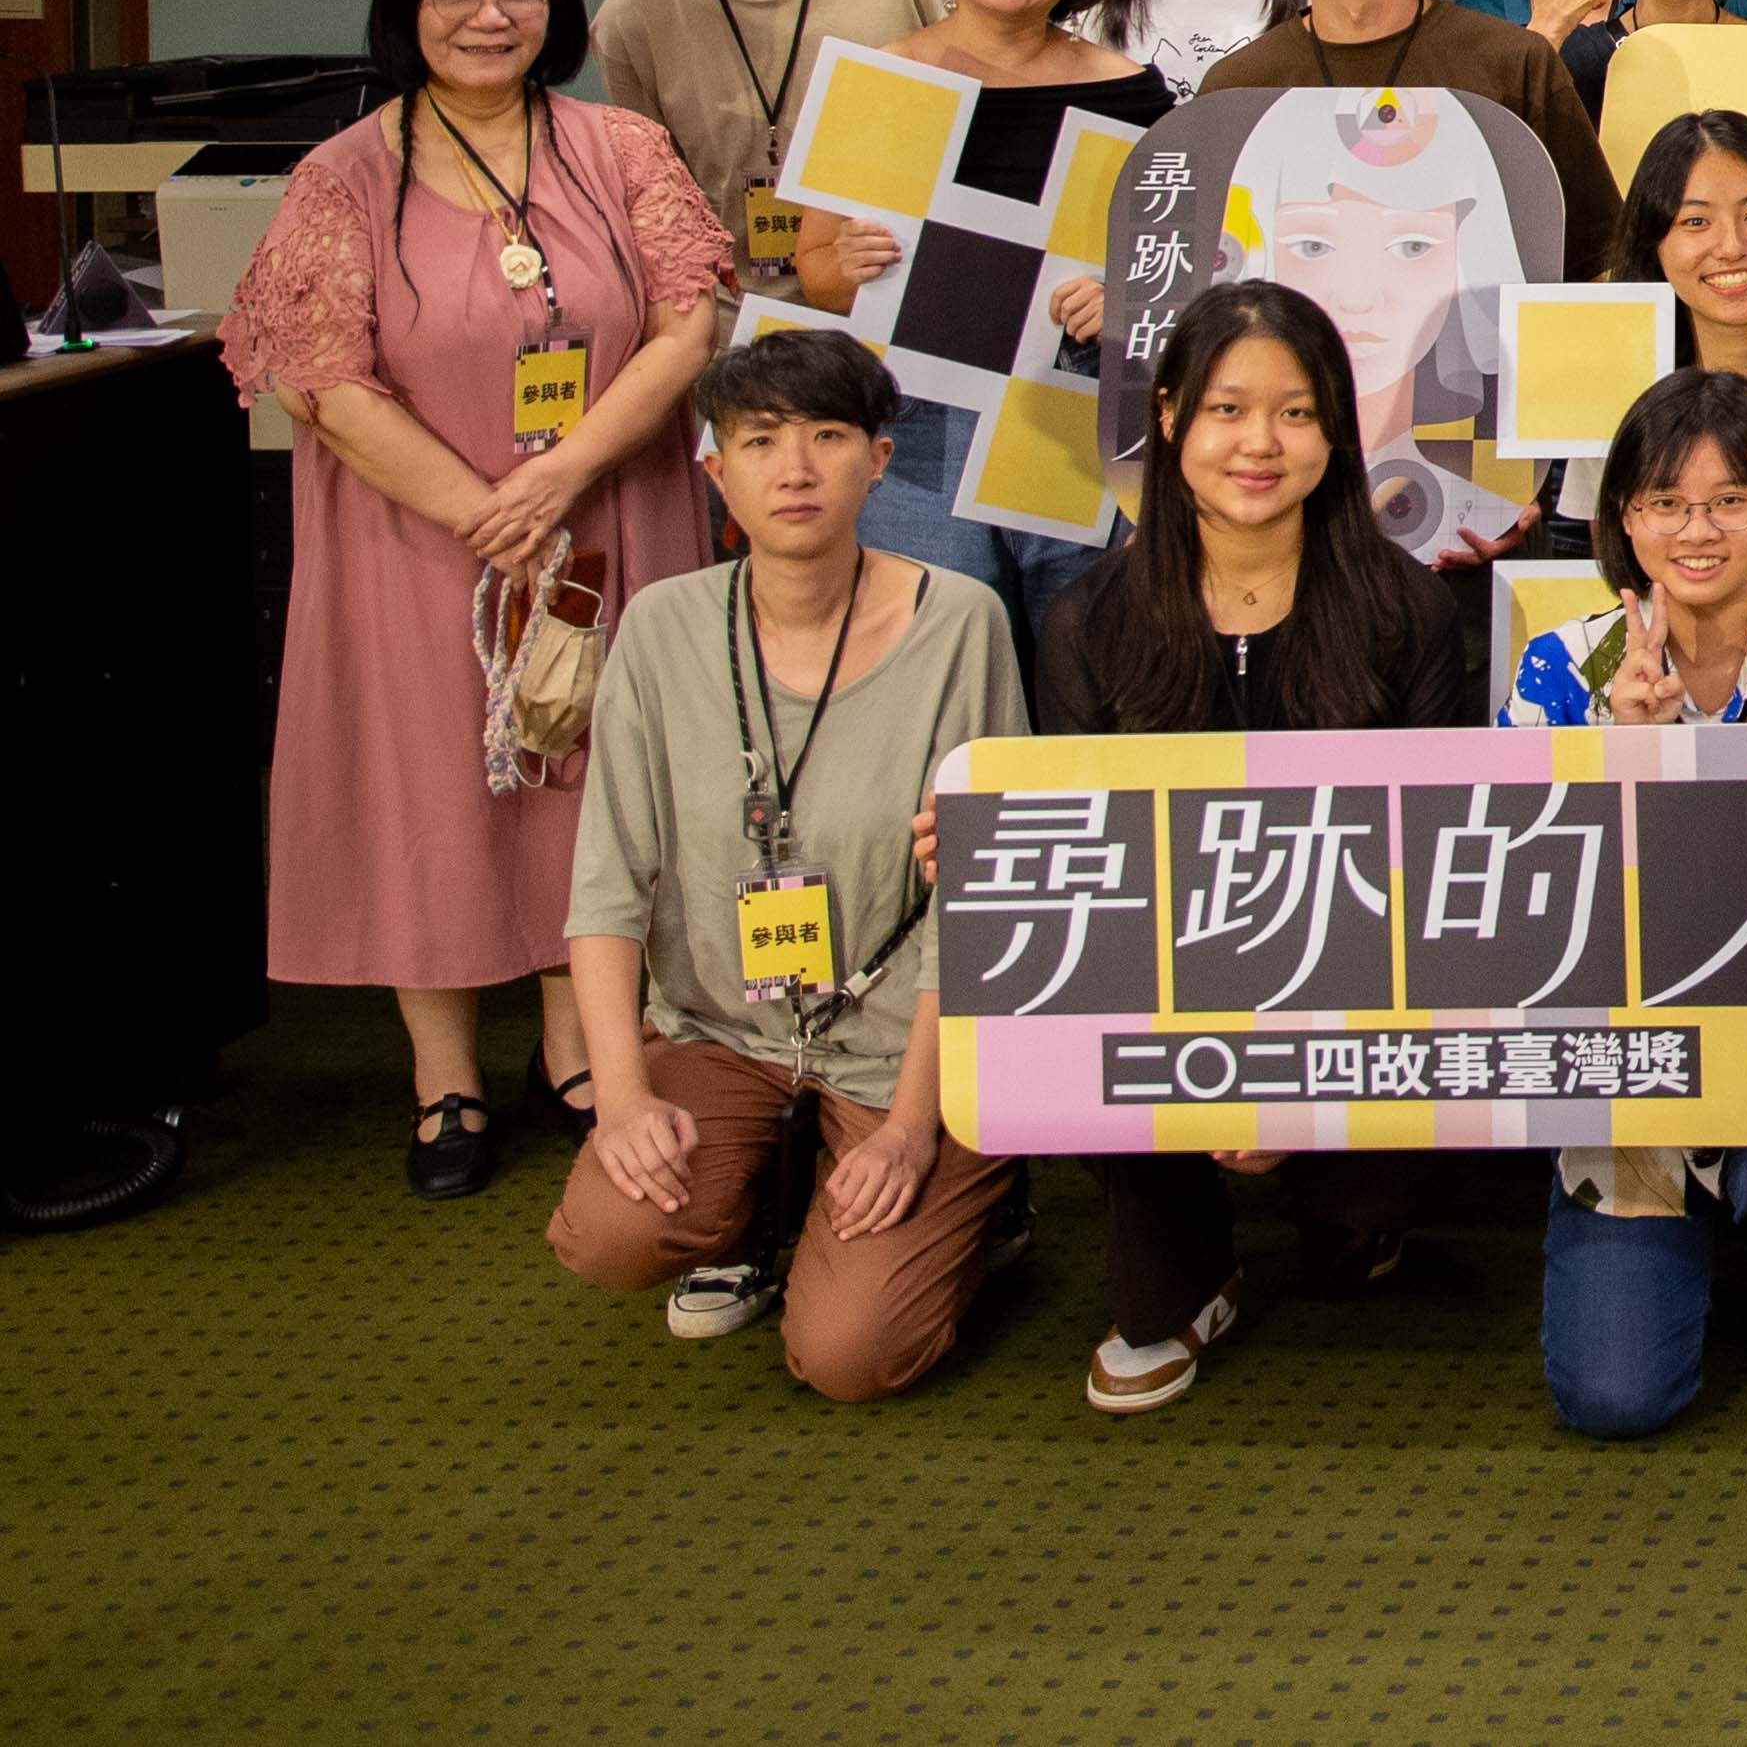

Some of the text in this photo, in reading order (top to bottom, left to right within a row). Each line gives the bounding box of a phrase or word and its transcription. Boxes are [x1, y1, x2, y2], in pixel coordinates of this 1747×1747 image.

[1112, 152, 1196, 461] 尋跡的
[522, 380, 577, 405] 參與者
[751, 921, 821, 949] 參與者
